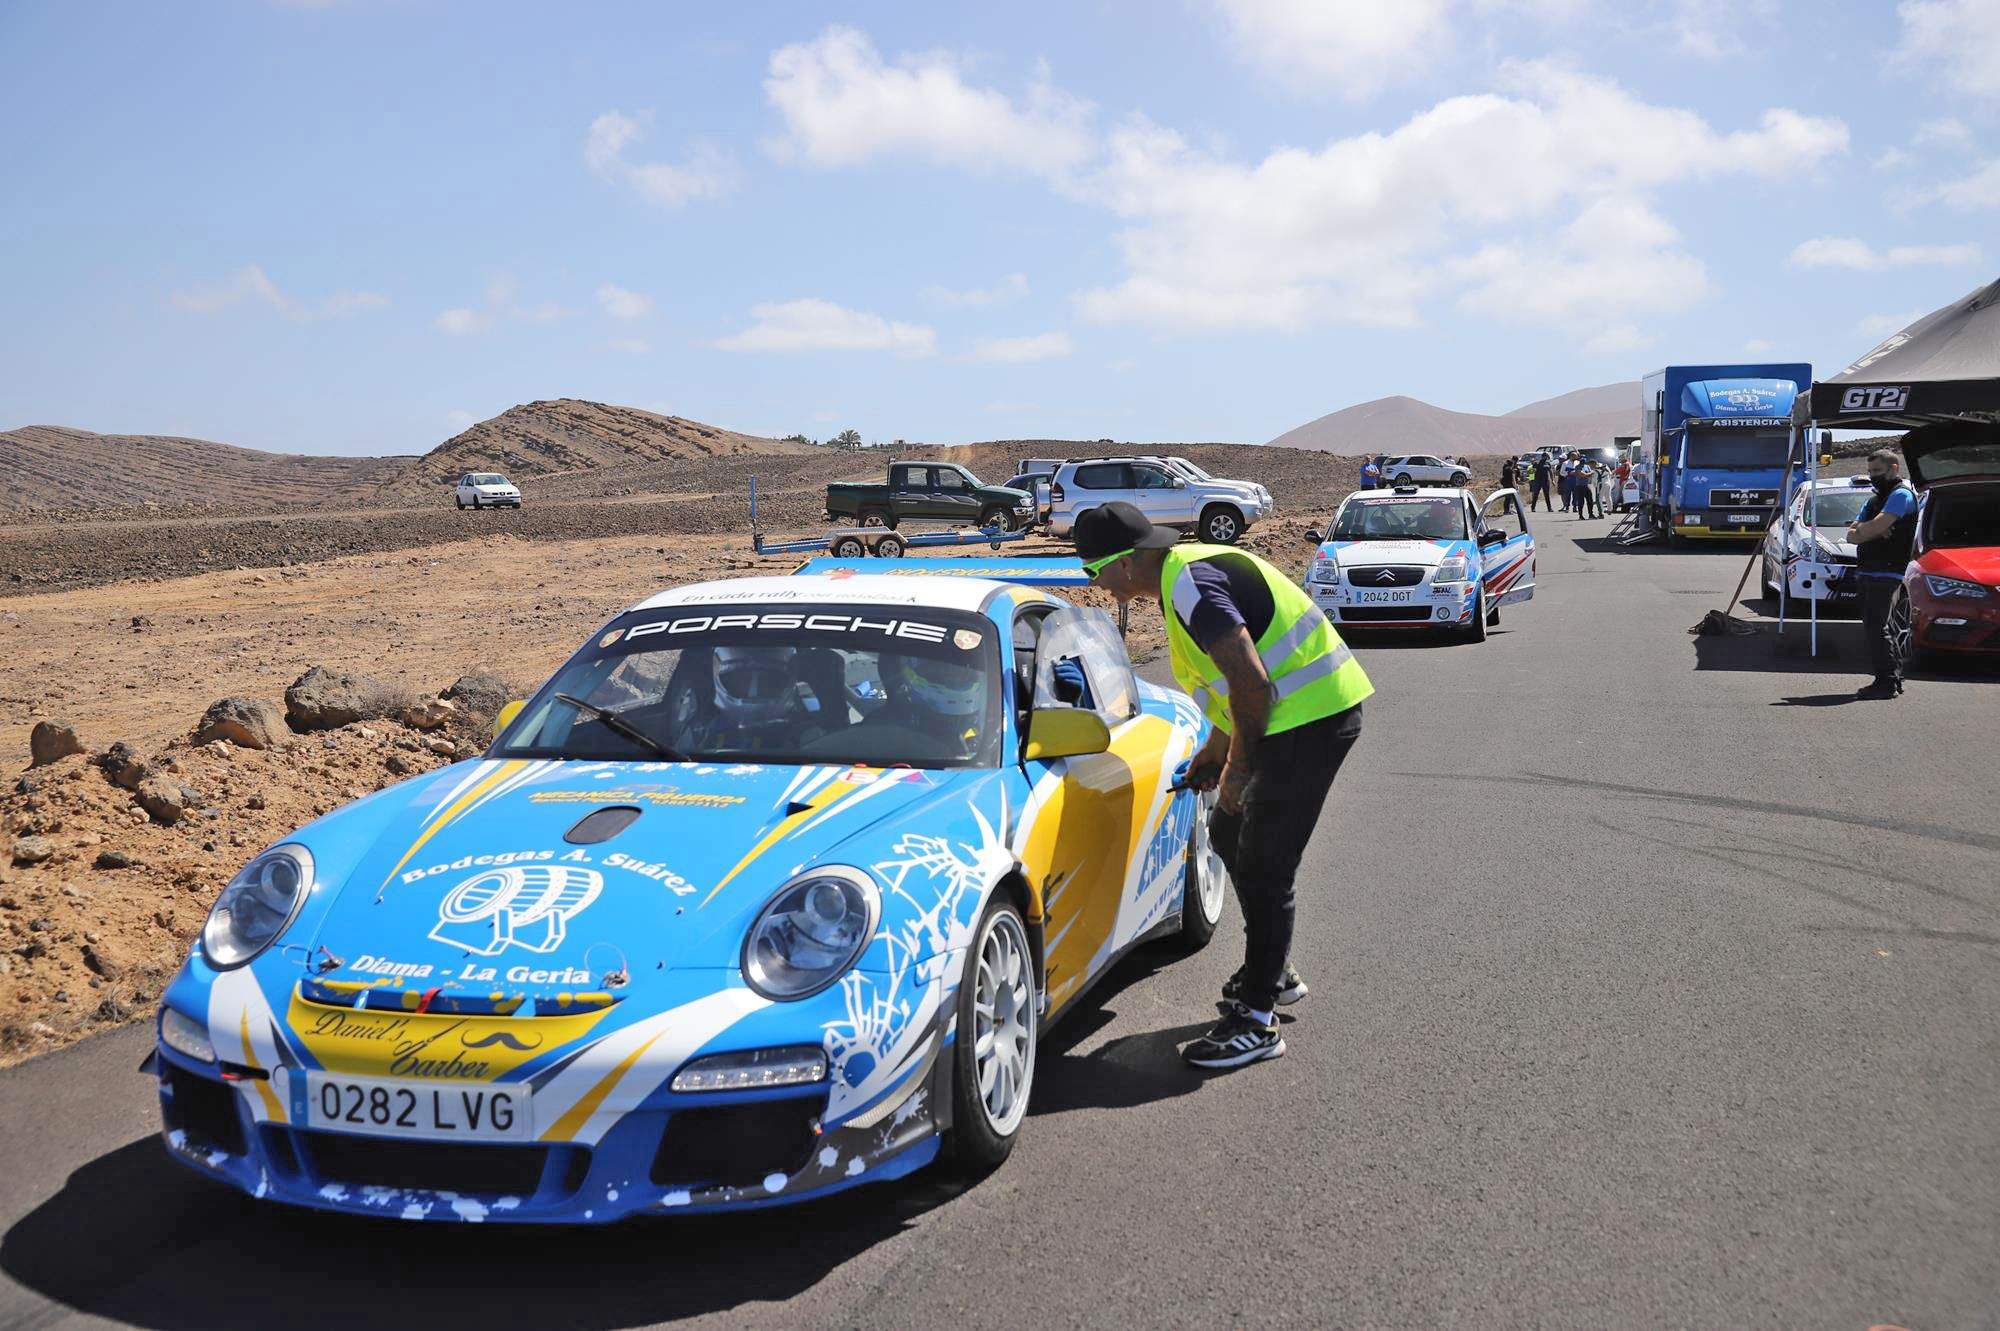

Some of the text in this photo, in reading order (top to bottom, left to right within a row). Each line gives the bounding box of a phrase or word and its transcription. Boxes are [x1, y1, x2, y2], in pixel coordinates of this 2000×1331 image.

[1843, 387, 1907, 408] GT2i
[1363, 591, 1412, 602] 2042 DGT
[624, 614, 946, 643] PORSCHE
[401, 848, 698, 897] Bodegas A. Suárez
[350, 955, 431, 978] Diama
[458, 963, 498, 980] La
[506, 967, 590, 985] Geria
[305, 1011, 410, 1041] Daniel's
[321, 1082, 417, 1128] 0282
[433, 1091, 513, 1130] LVG
